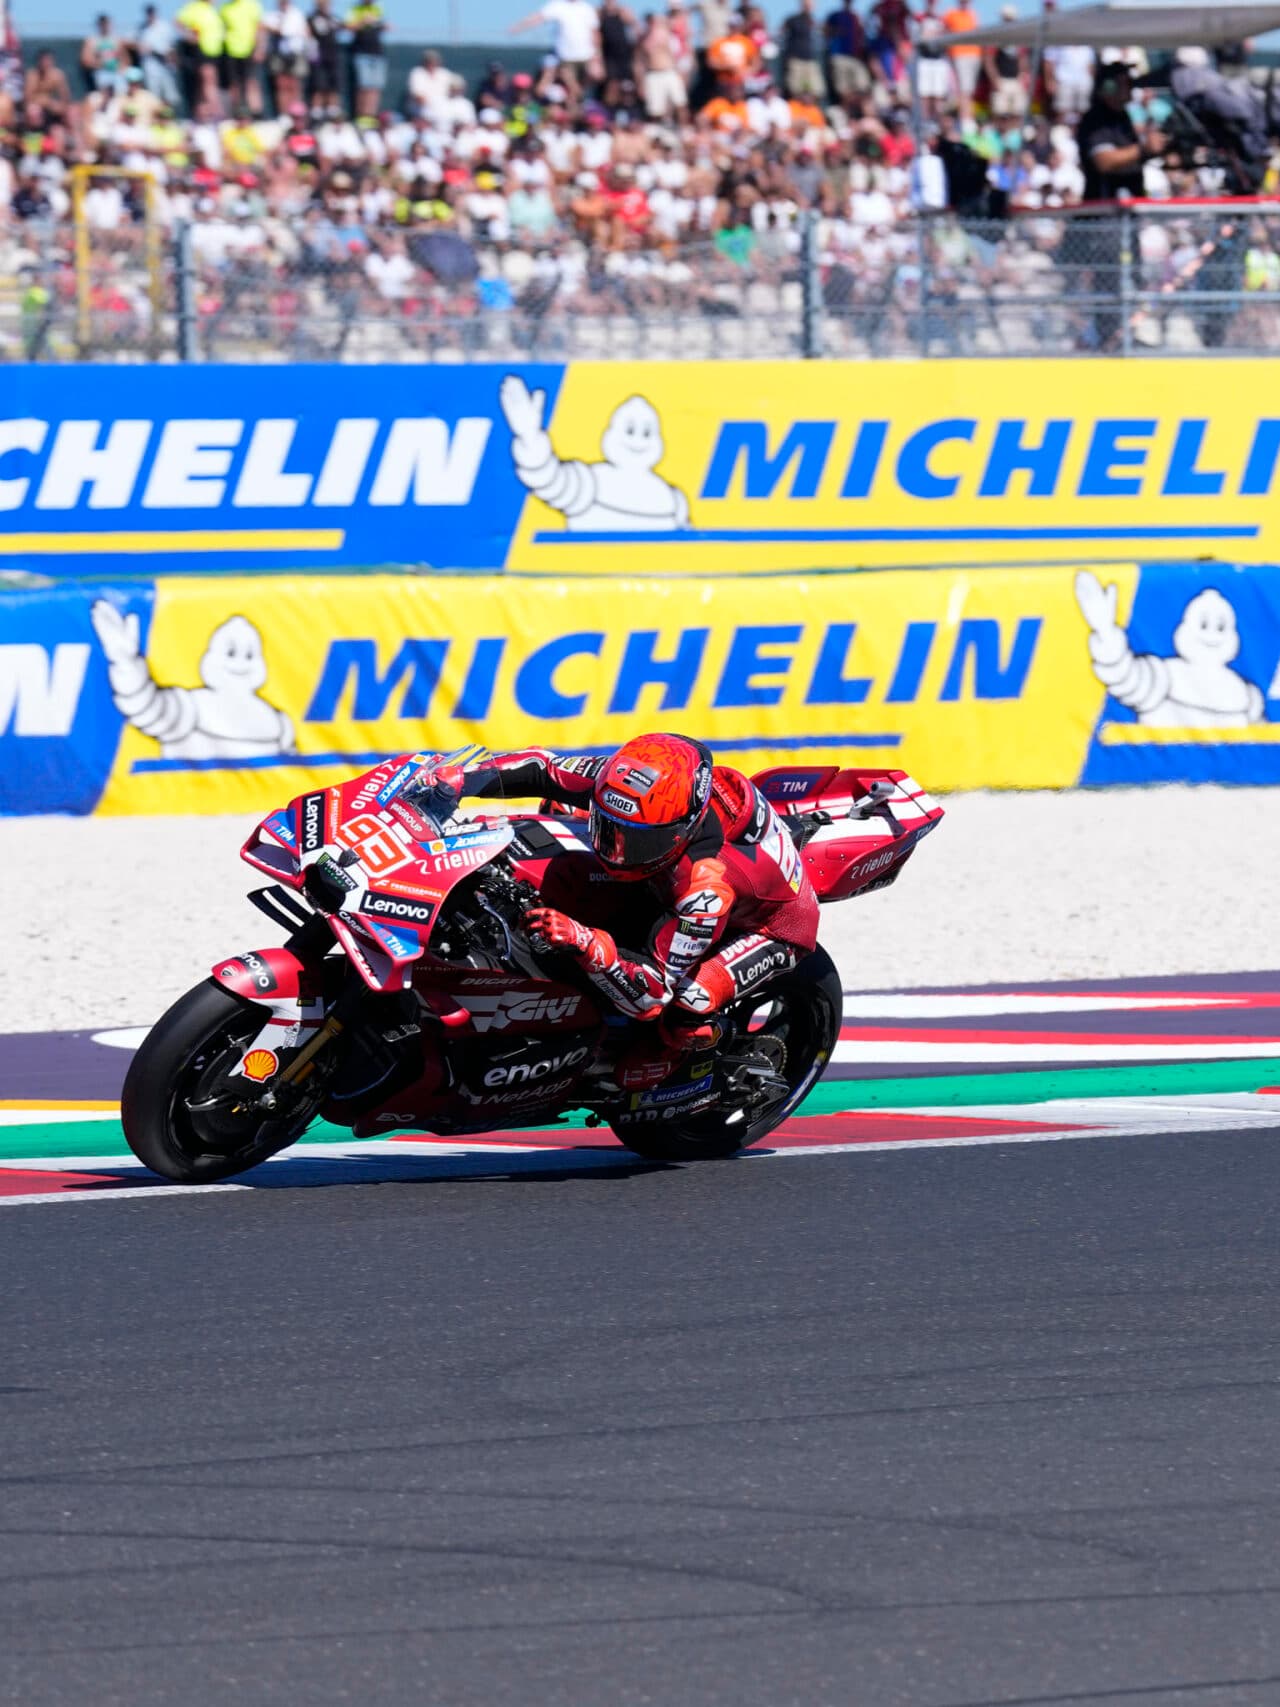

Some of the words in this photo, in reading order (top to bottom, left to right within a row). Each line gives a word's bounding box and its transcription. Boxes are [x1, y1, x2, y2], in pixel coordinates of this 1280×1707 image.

[305, 618, 1042, 723] MICHELIN
[782, 781, 808, 793] TIM
[606, 792, 634, 813] SHOEI
[276, 822, 296, 842] TIM
[305, 795, 322, 850] Lenovo
[434, 848, 488, 873] riello
[859, 850, 894, 878] riello
[363, 894, 430, 921] Lenovo
[387, 935, 408, 958] TIM
[459, 977, 529, 988] DUCATI
[737, 951, 786, 987] Lenovo
[612, 967, 641, 999] Lenovo
[483, 1046, 589, 1088] enovo
